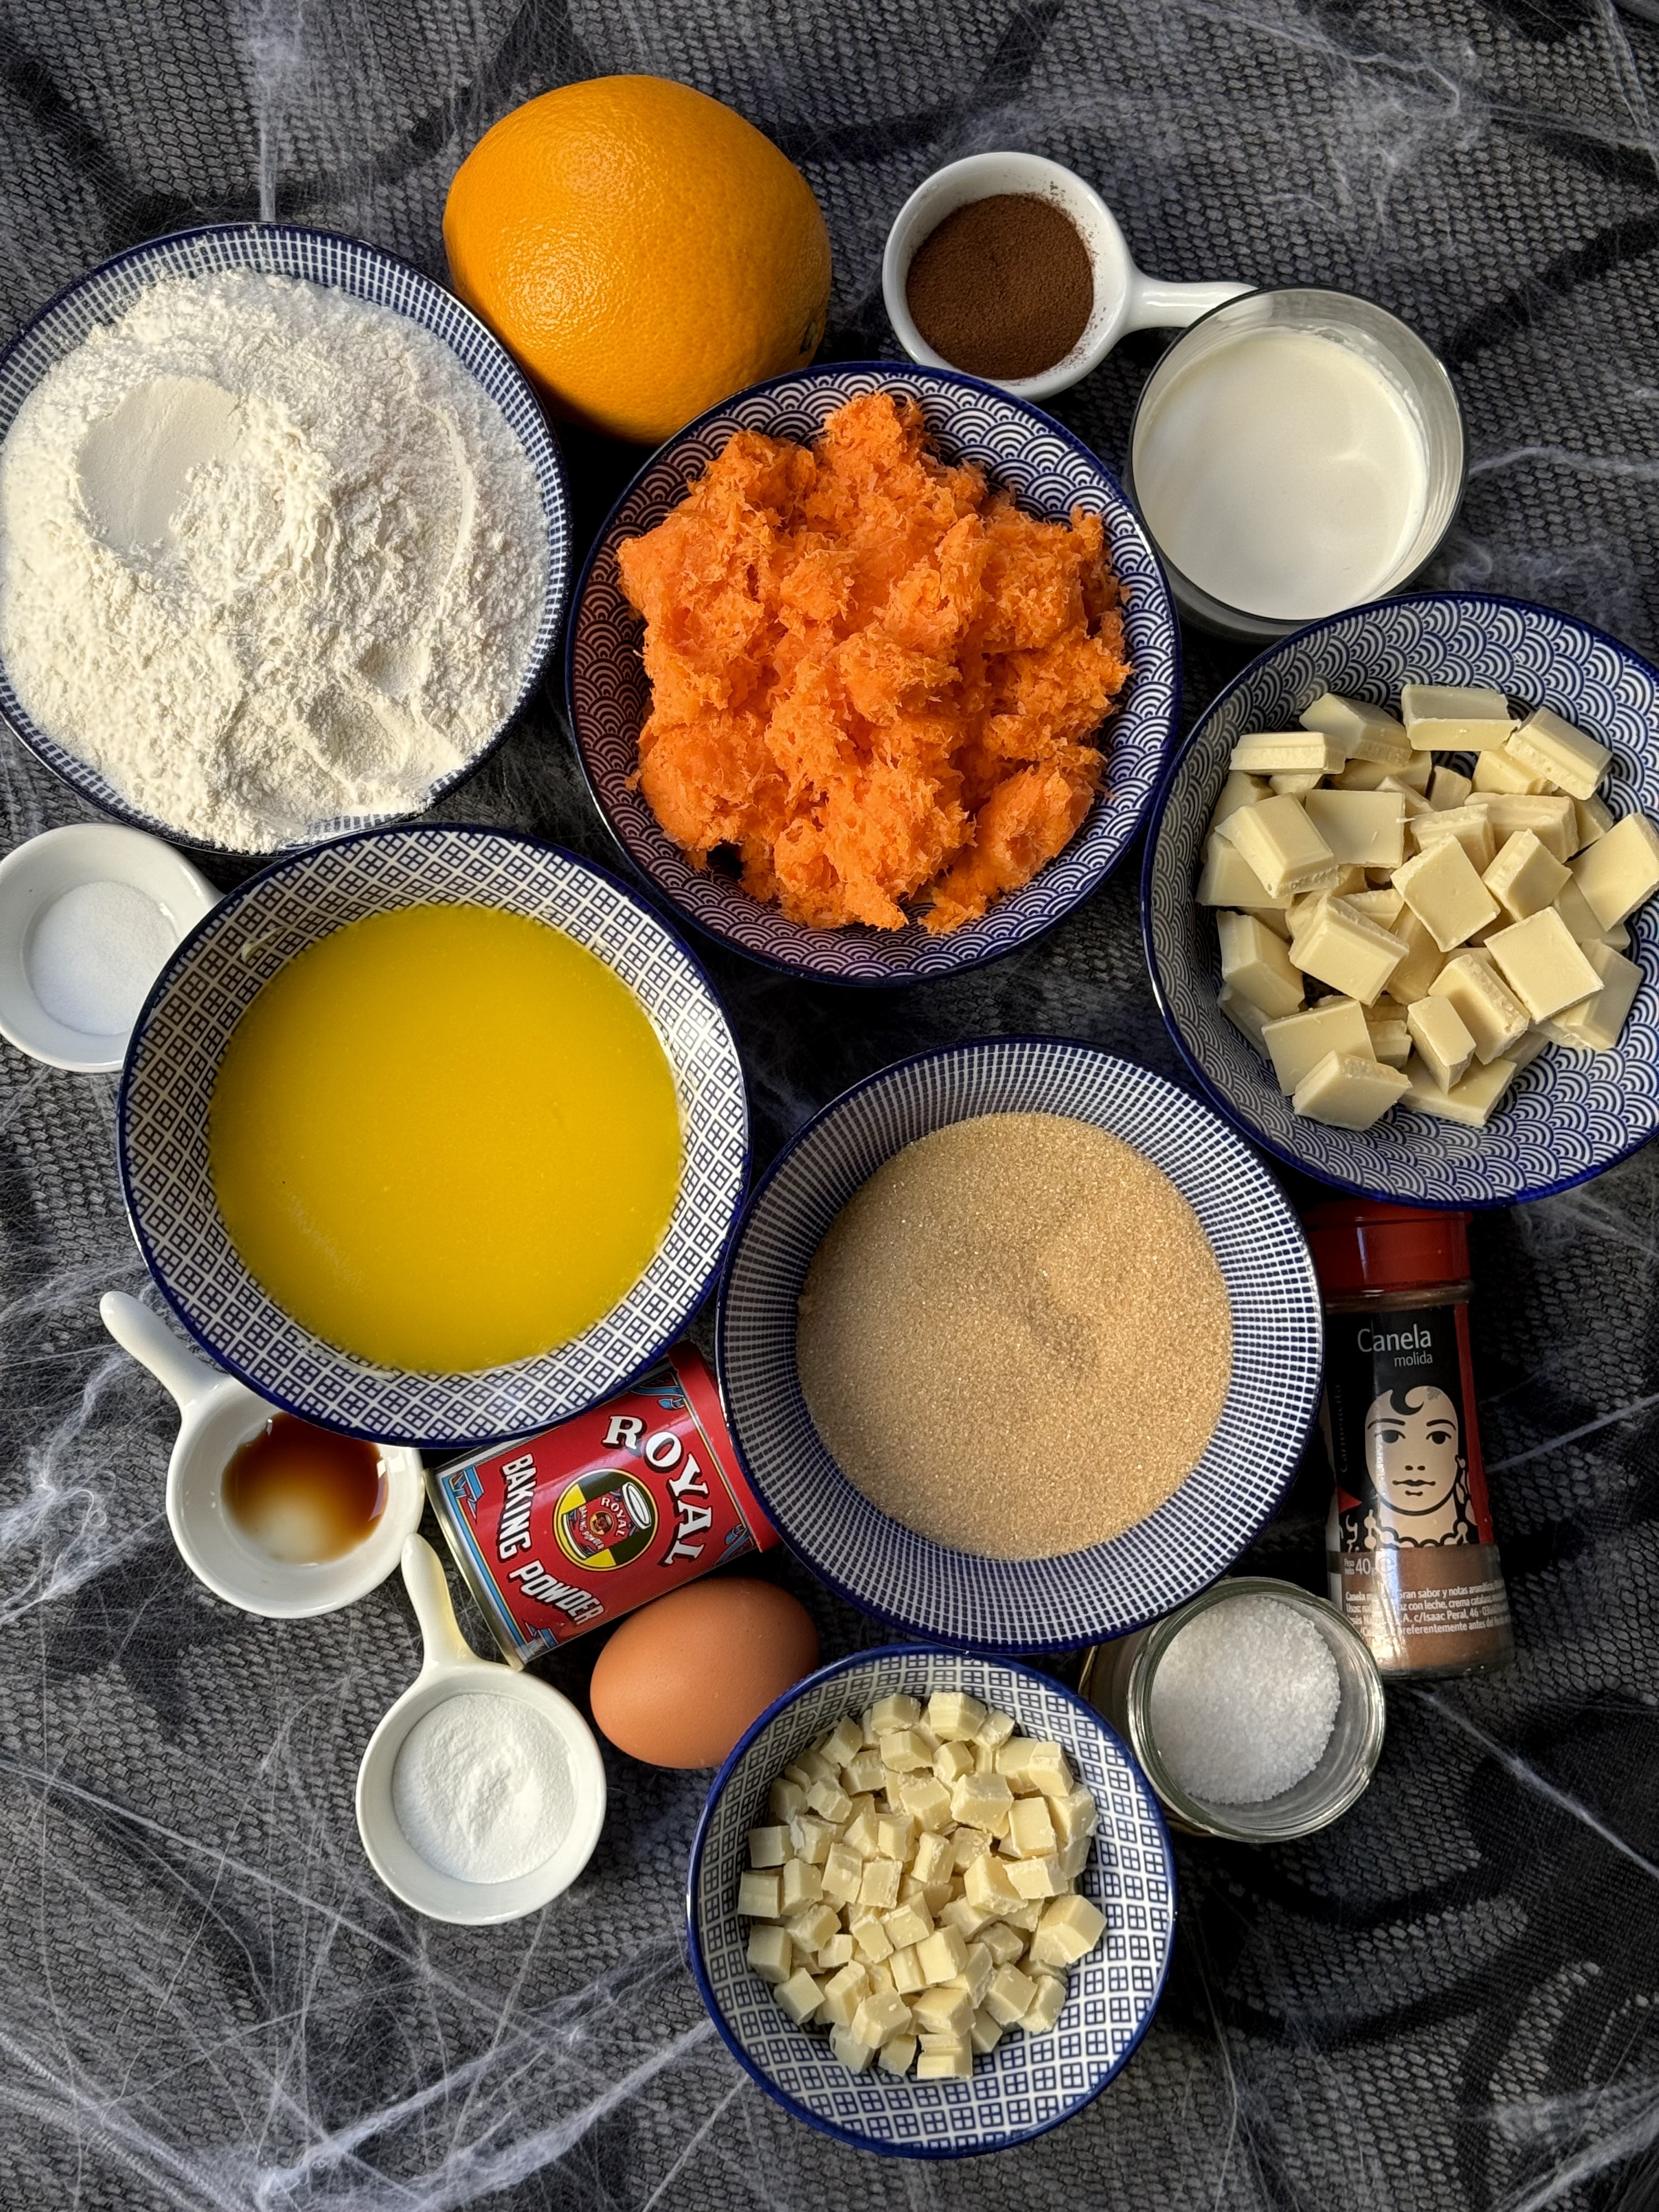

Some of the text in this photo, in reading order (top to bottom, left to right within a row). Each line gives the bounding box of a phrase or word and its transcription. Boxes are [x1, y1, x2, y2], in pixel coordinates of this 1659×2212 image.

[1357, 1323, 1431, 1352] Canela
[1394, 1350, 1433, 1367] molida
[602, 1415, 713, 1566] ROYAL
[601, 1497, 627, 1537] ROYAL
[499, 1453, 605, 1626] BAKING POWDER
[1418, 1588, 1440, 1598] sabor
[1442, 1589, 1447, 1599] y
[1448, 1585, 1468, 1596] notas
[1408, 1601, 1423, 1611] con
[1424, 1599, 1448, 1610] leche,
[1448, 1599, 1470, 1608] crema
[1414, 1612, 1445, 1623] c/Isaac
[1447, 1609, 1469, 1620] Peral,
[1470, 1607, 1479, 1617] 46
[1469, 1619, 1486, 1630] antes
